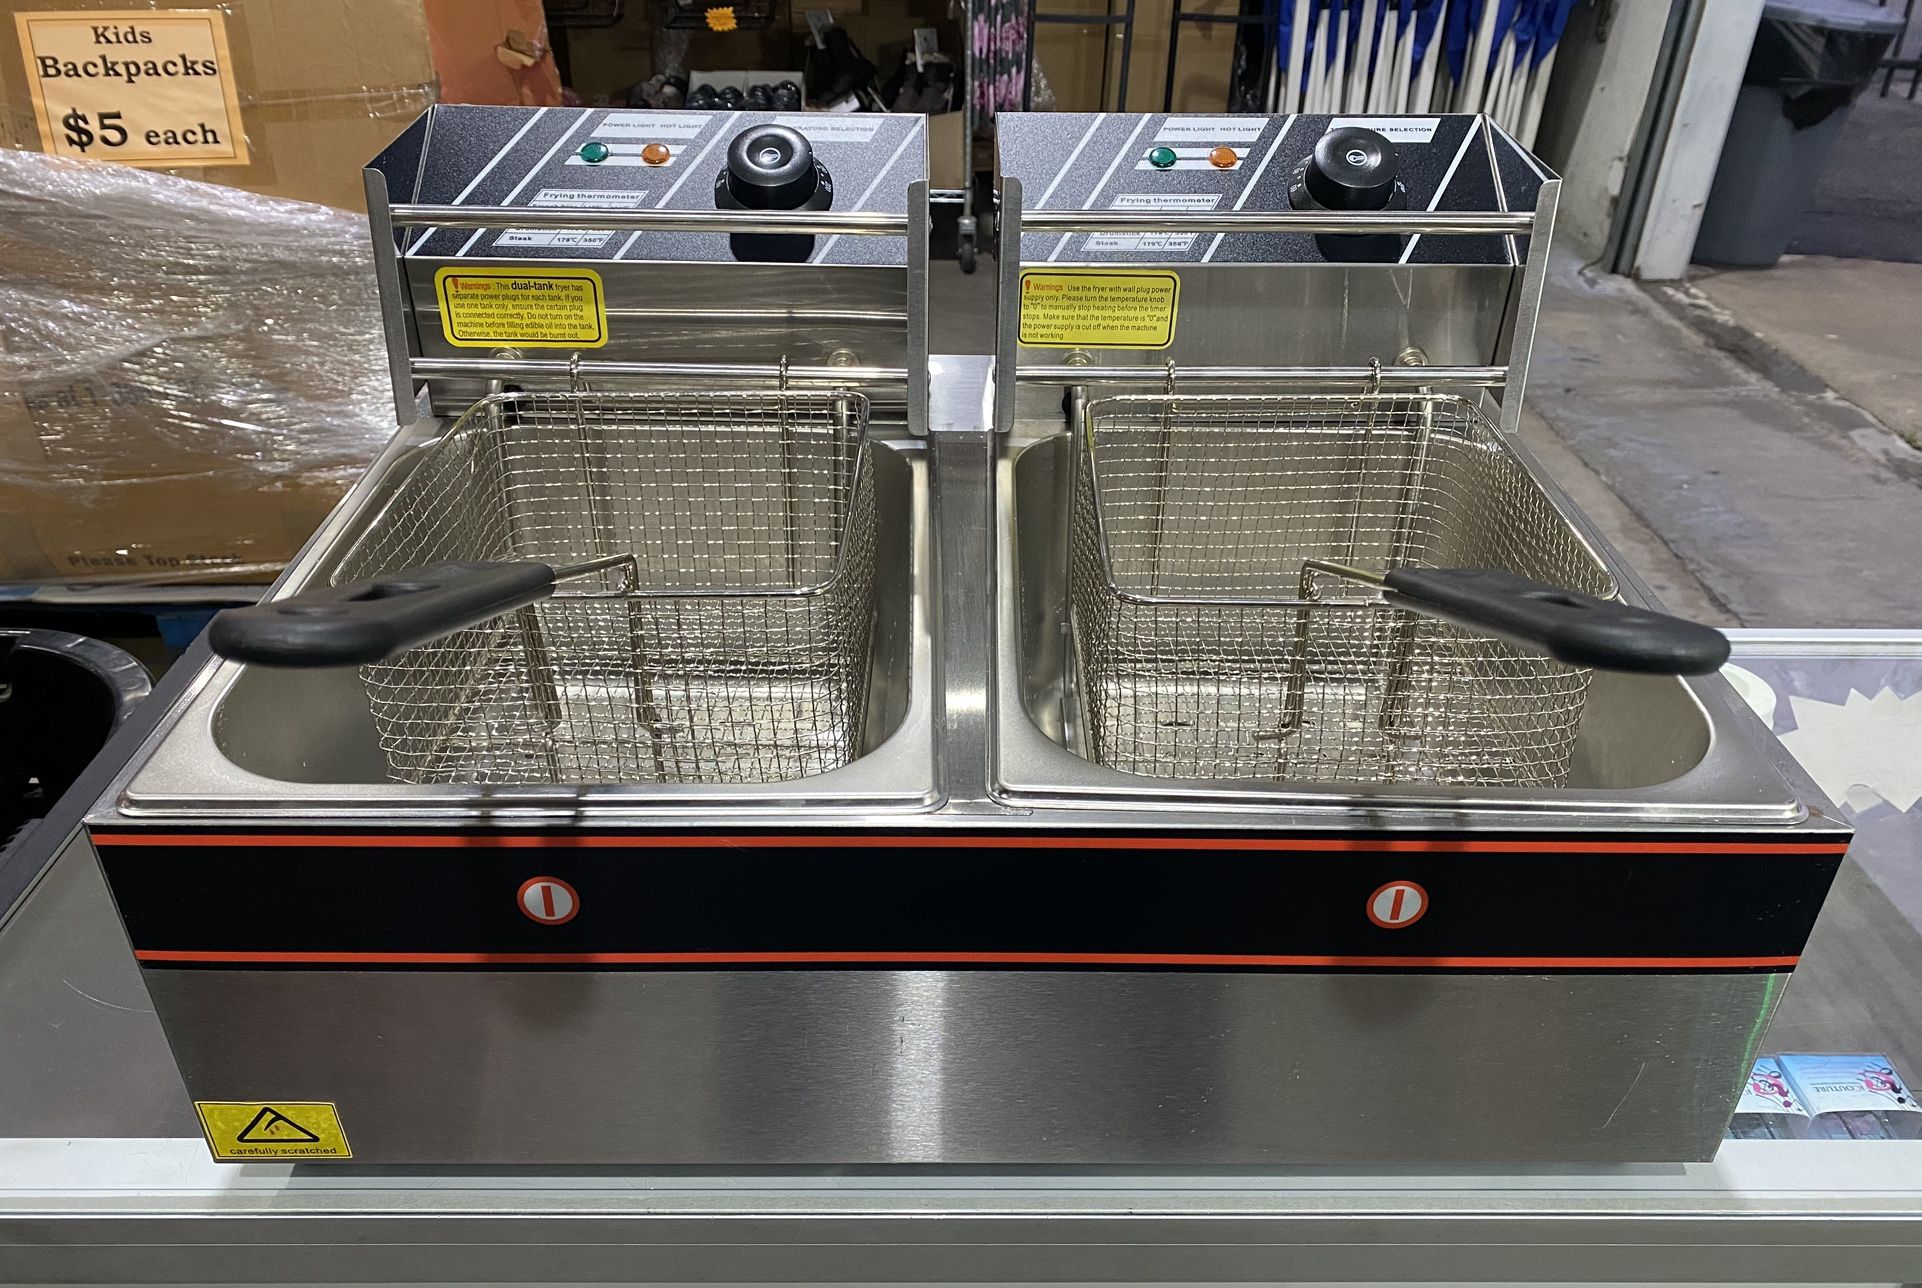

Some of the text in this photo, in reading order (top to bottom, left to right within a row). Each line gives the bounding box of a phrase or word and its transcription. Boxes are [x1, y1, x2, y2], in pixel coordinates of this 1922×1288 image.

[91, 26, 152, 44] Kids
[36, 54, 217, 83] Backpacks
[62, 107, 220, 152] $5 each
[511, 281, 554, 290] dual-tank
[555, 284, 570, 292] fryer
[1034, 283, 1064, 292] Warnings
[68, 554, 137, 567] Please
[145, 554, 180, 568] Top
[230, 1146, 337, 1156] carefully scratched
